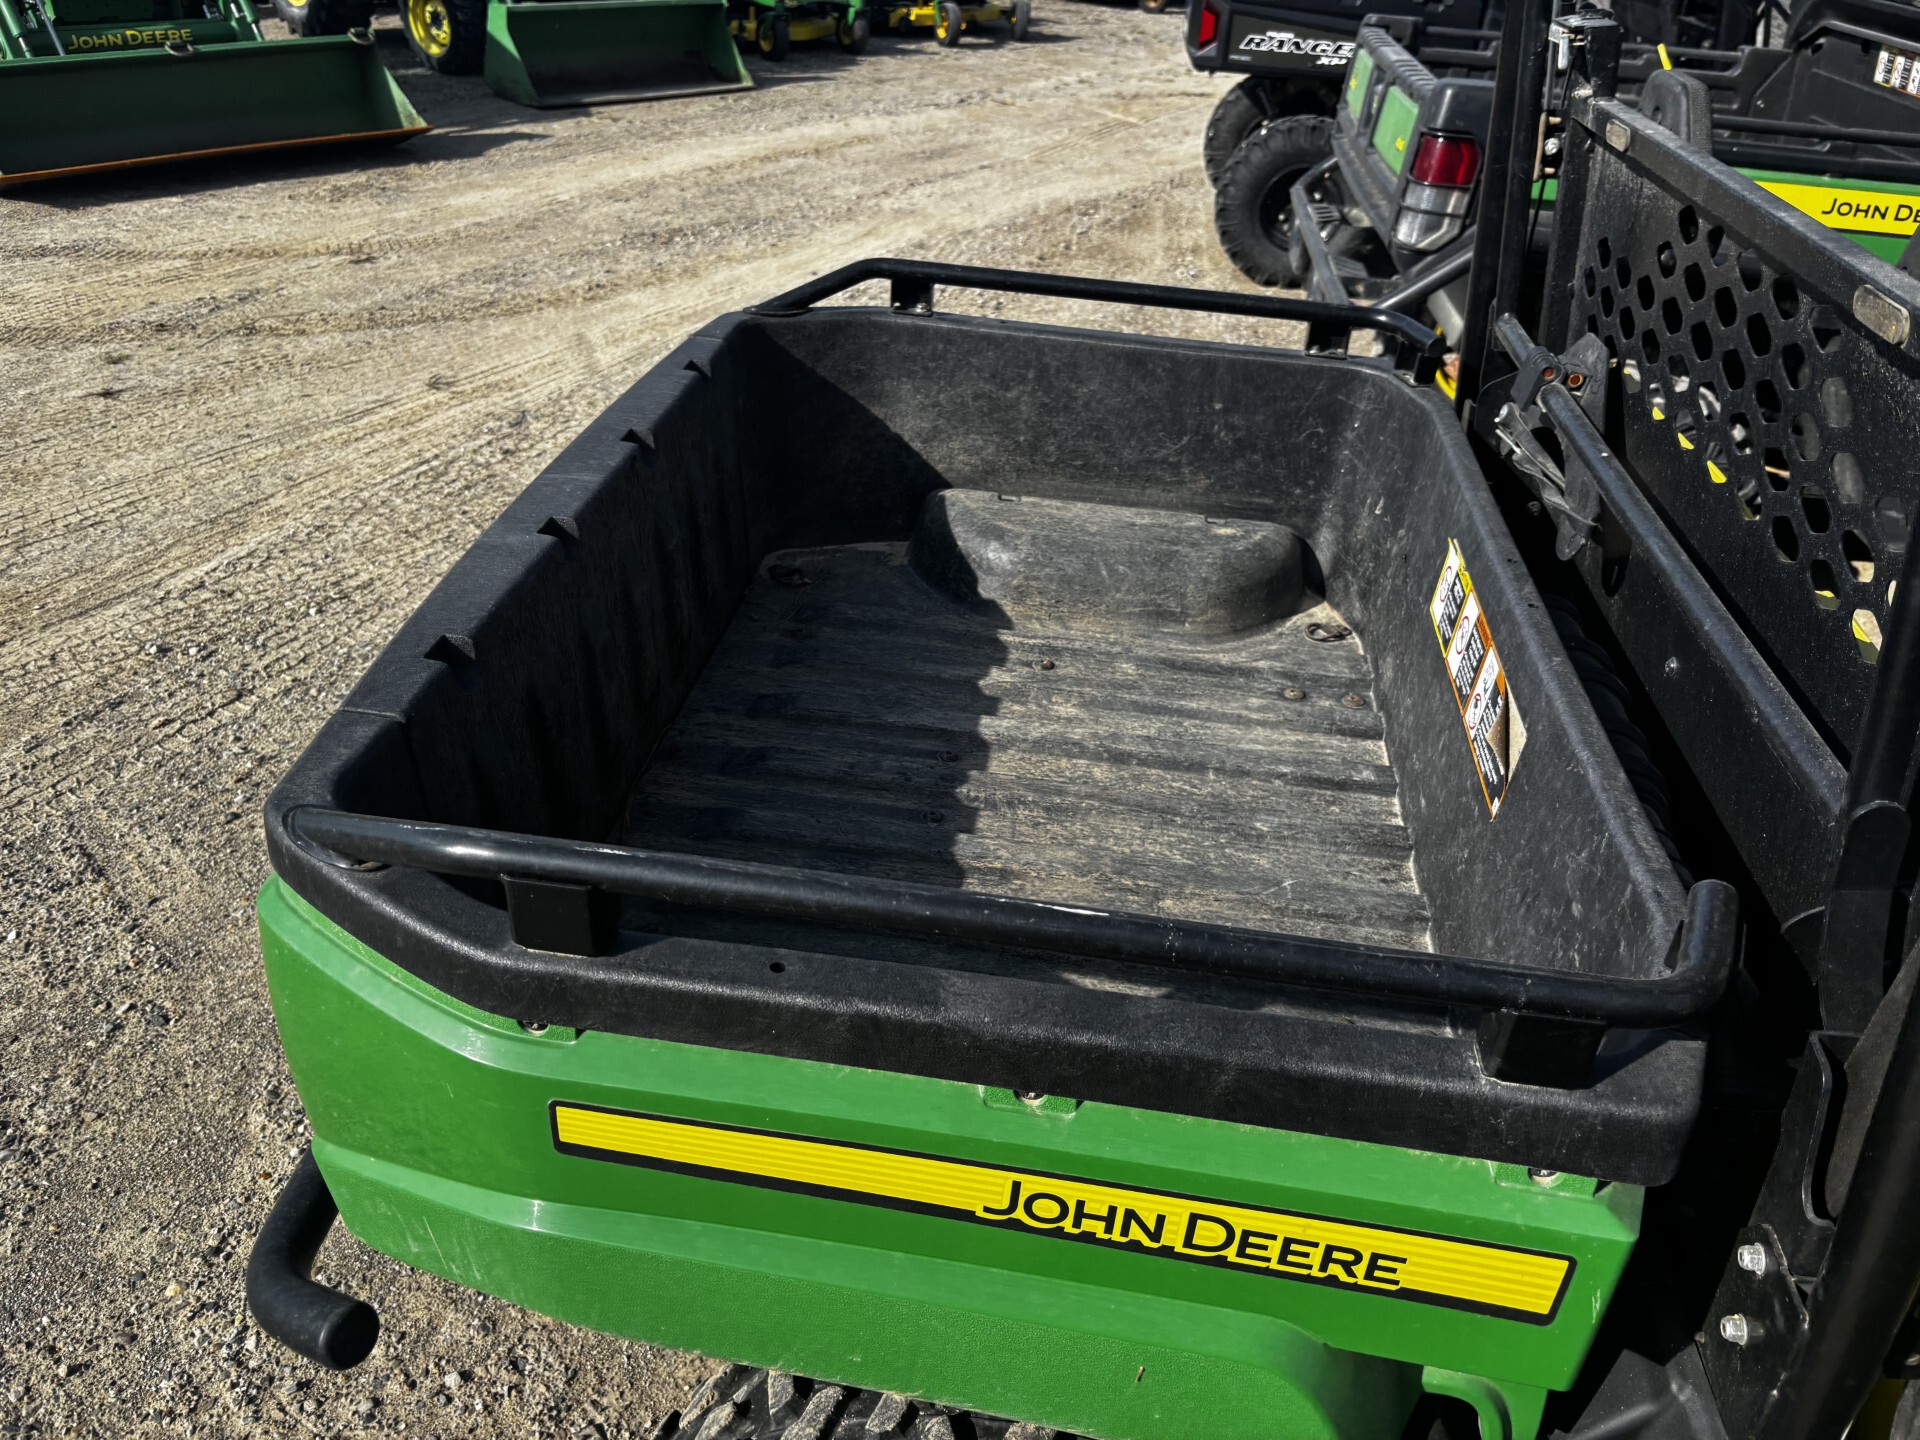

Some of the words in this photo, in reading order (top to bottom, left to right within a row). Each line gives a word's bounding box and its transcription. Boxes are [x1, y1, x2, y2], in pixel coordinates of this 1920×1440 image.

[68, 34, 123, 50] JOHN
[125, 28, 193, 45] DEERE
[1239, 34, 1356, 57] RANGE
[1821, 197, 1889, 220] JOHN
[981, 1180, 1165, 1245] JOHN
[1181, 1210, 1408, 1287] DEERE
